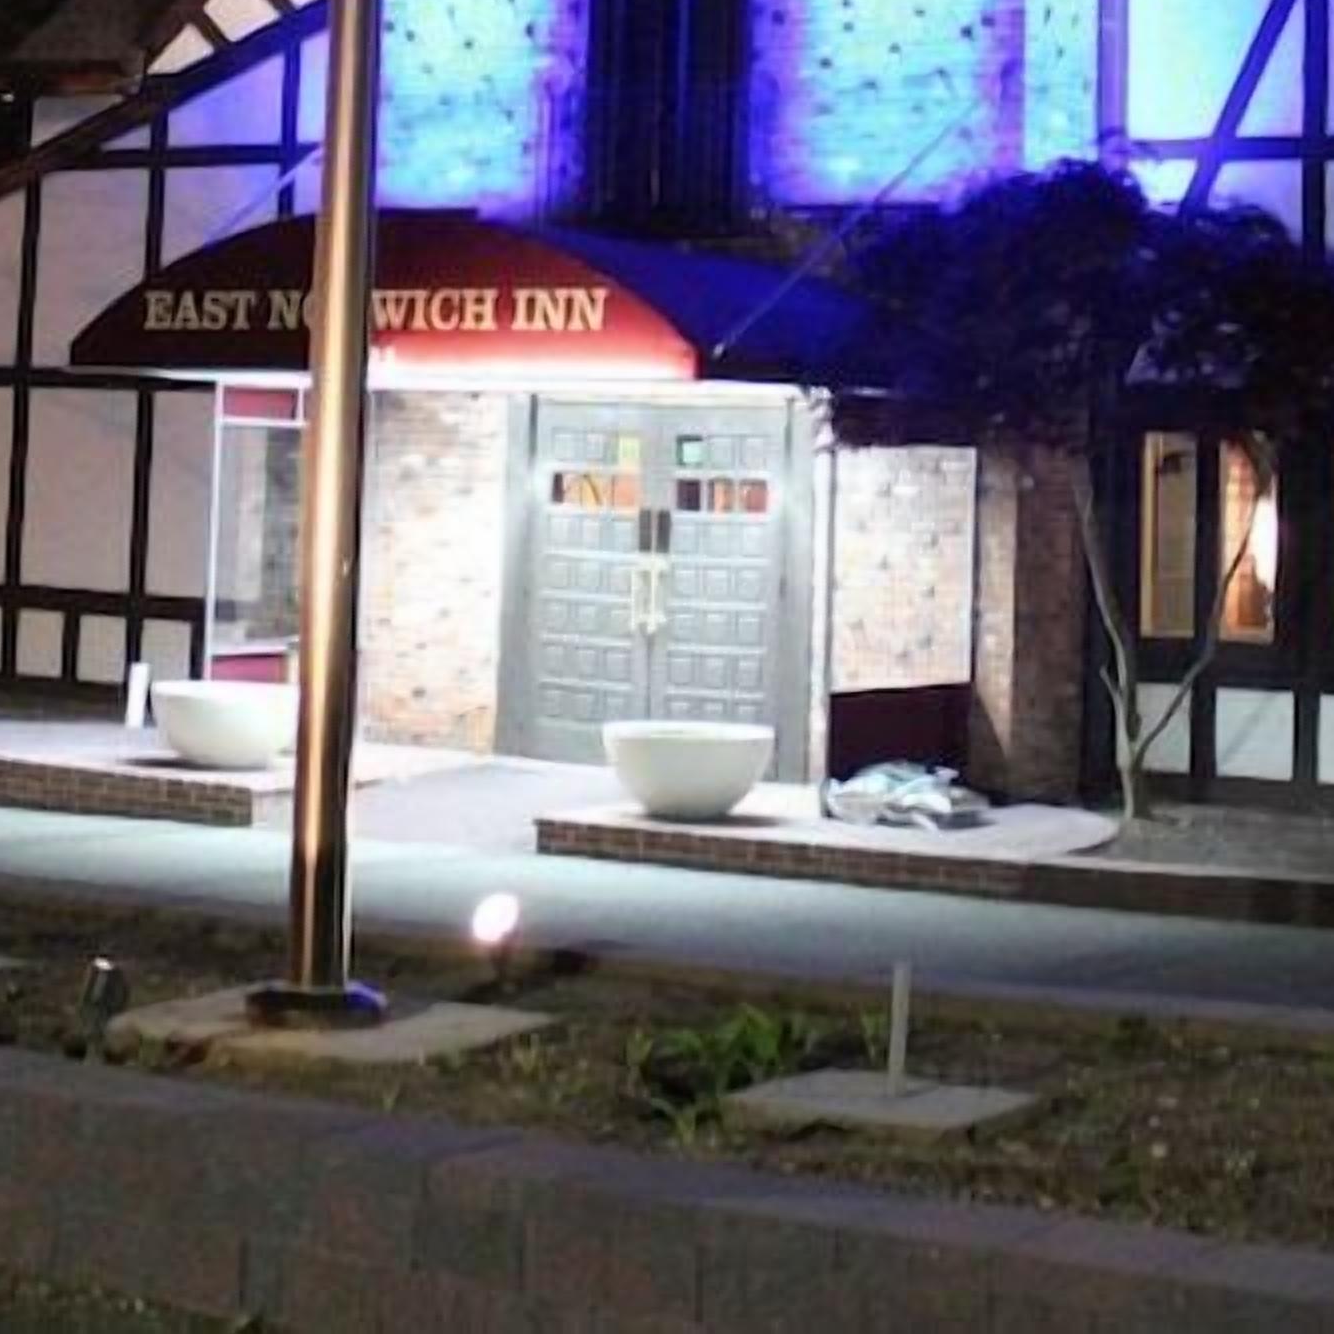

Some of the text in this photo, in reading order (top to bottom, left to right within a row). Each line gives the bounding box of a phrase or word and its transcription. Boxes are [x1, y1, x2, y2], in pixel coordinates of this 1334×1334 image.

[144, 288, 608, 331] EAST NWICH INN
